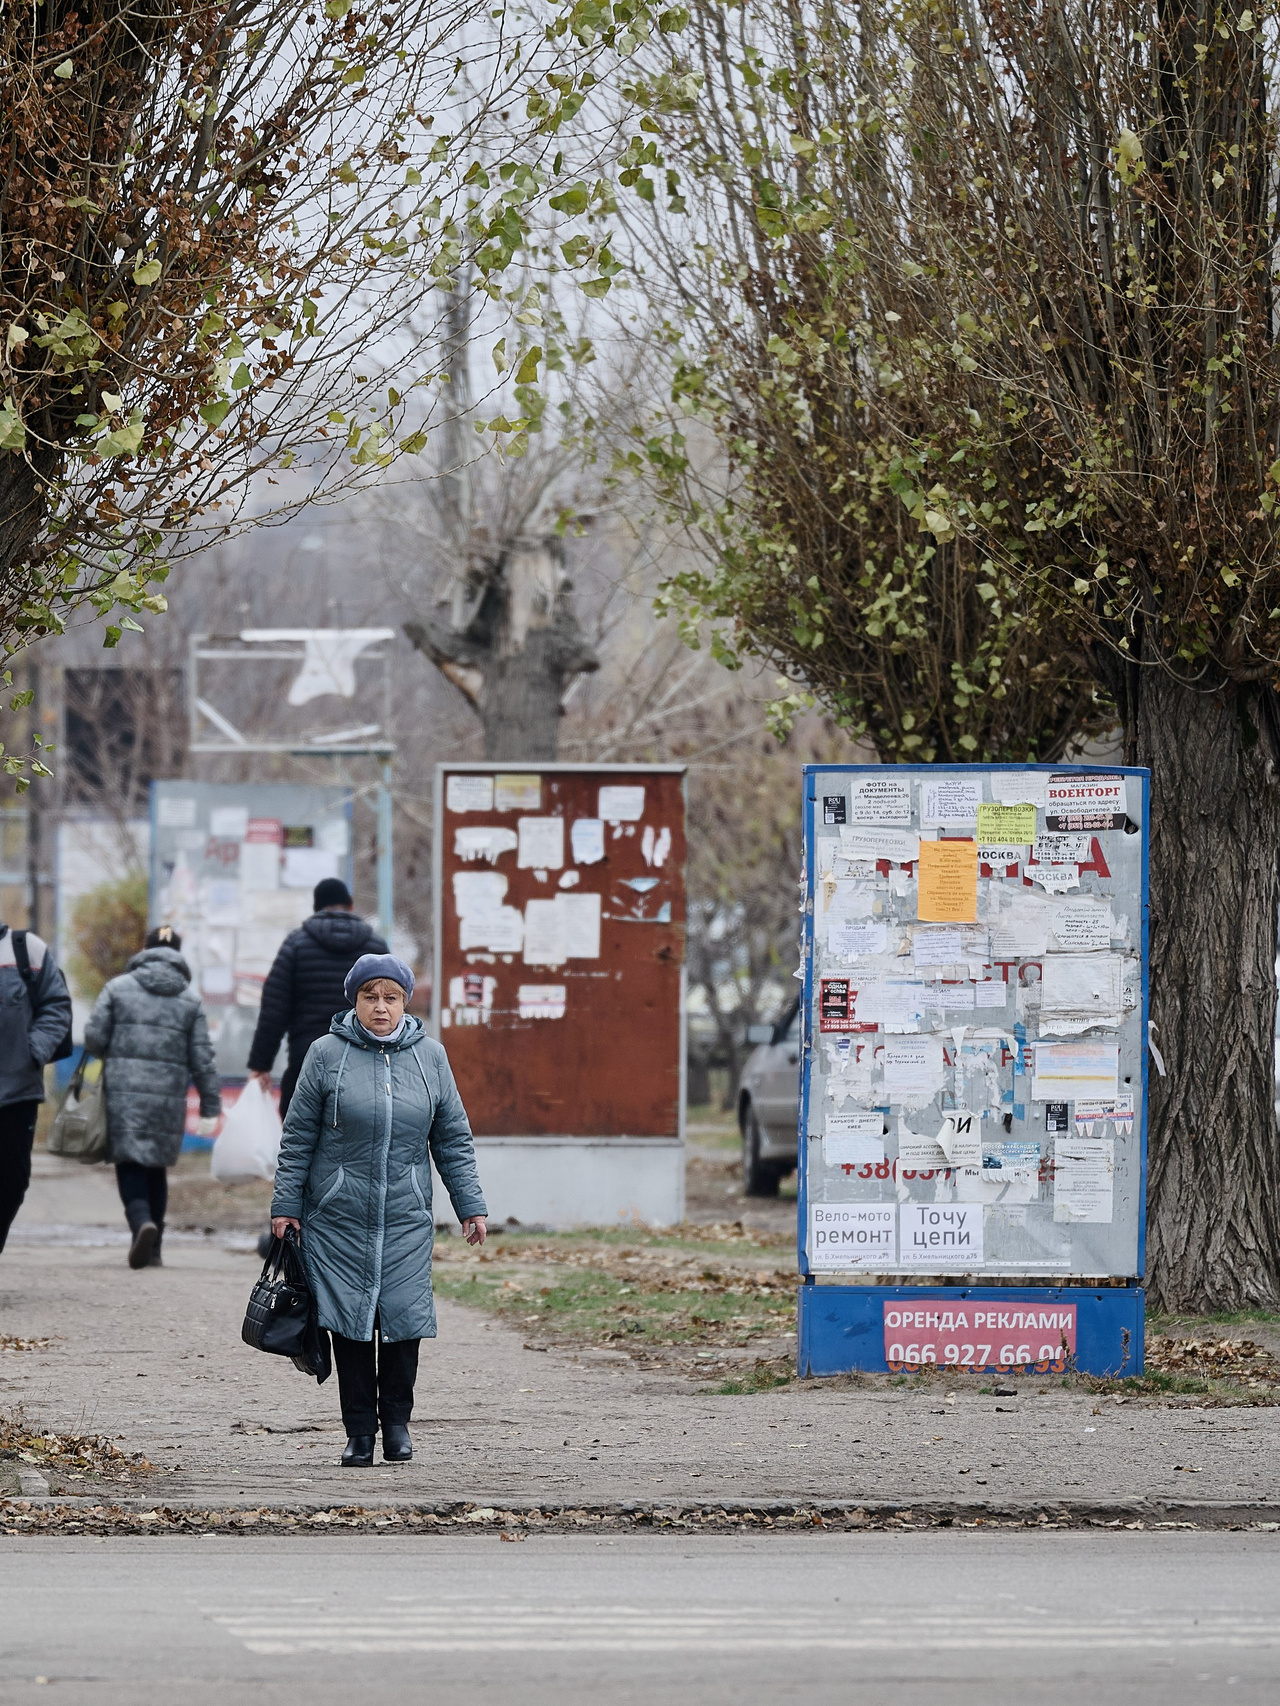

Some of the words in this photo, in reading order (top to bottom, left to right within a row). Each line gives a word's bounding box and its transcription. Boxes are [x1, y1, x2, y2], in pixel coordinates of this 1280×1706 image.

[1049, 787, 1120, 798] ВОЕНТОРГ
[852, 836, 906, 845] ГРУЗОПЕРЕВОЗКИ
[815, 1210, 891, 1222] Вело-мото
[916, 1207, 967, 1230] Точу
[816, 1230, 892, 1248] ремонт
[914, 1230, 970, 1248] цепи
[888, 1312, 968, 1332] ОРЕНДА
[974, 1313, 1072, 1329] РЕКЛАМИ
[888, 1344, 936, 1364] 066
[944, 1344, 991, 1365] 927
[1000, 1345, 1031, 1365] 66
